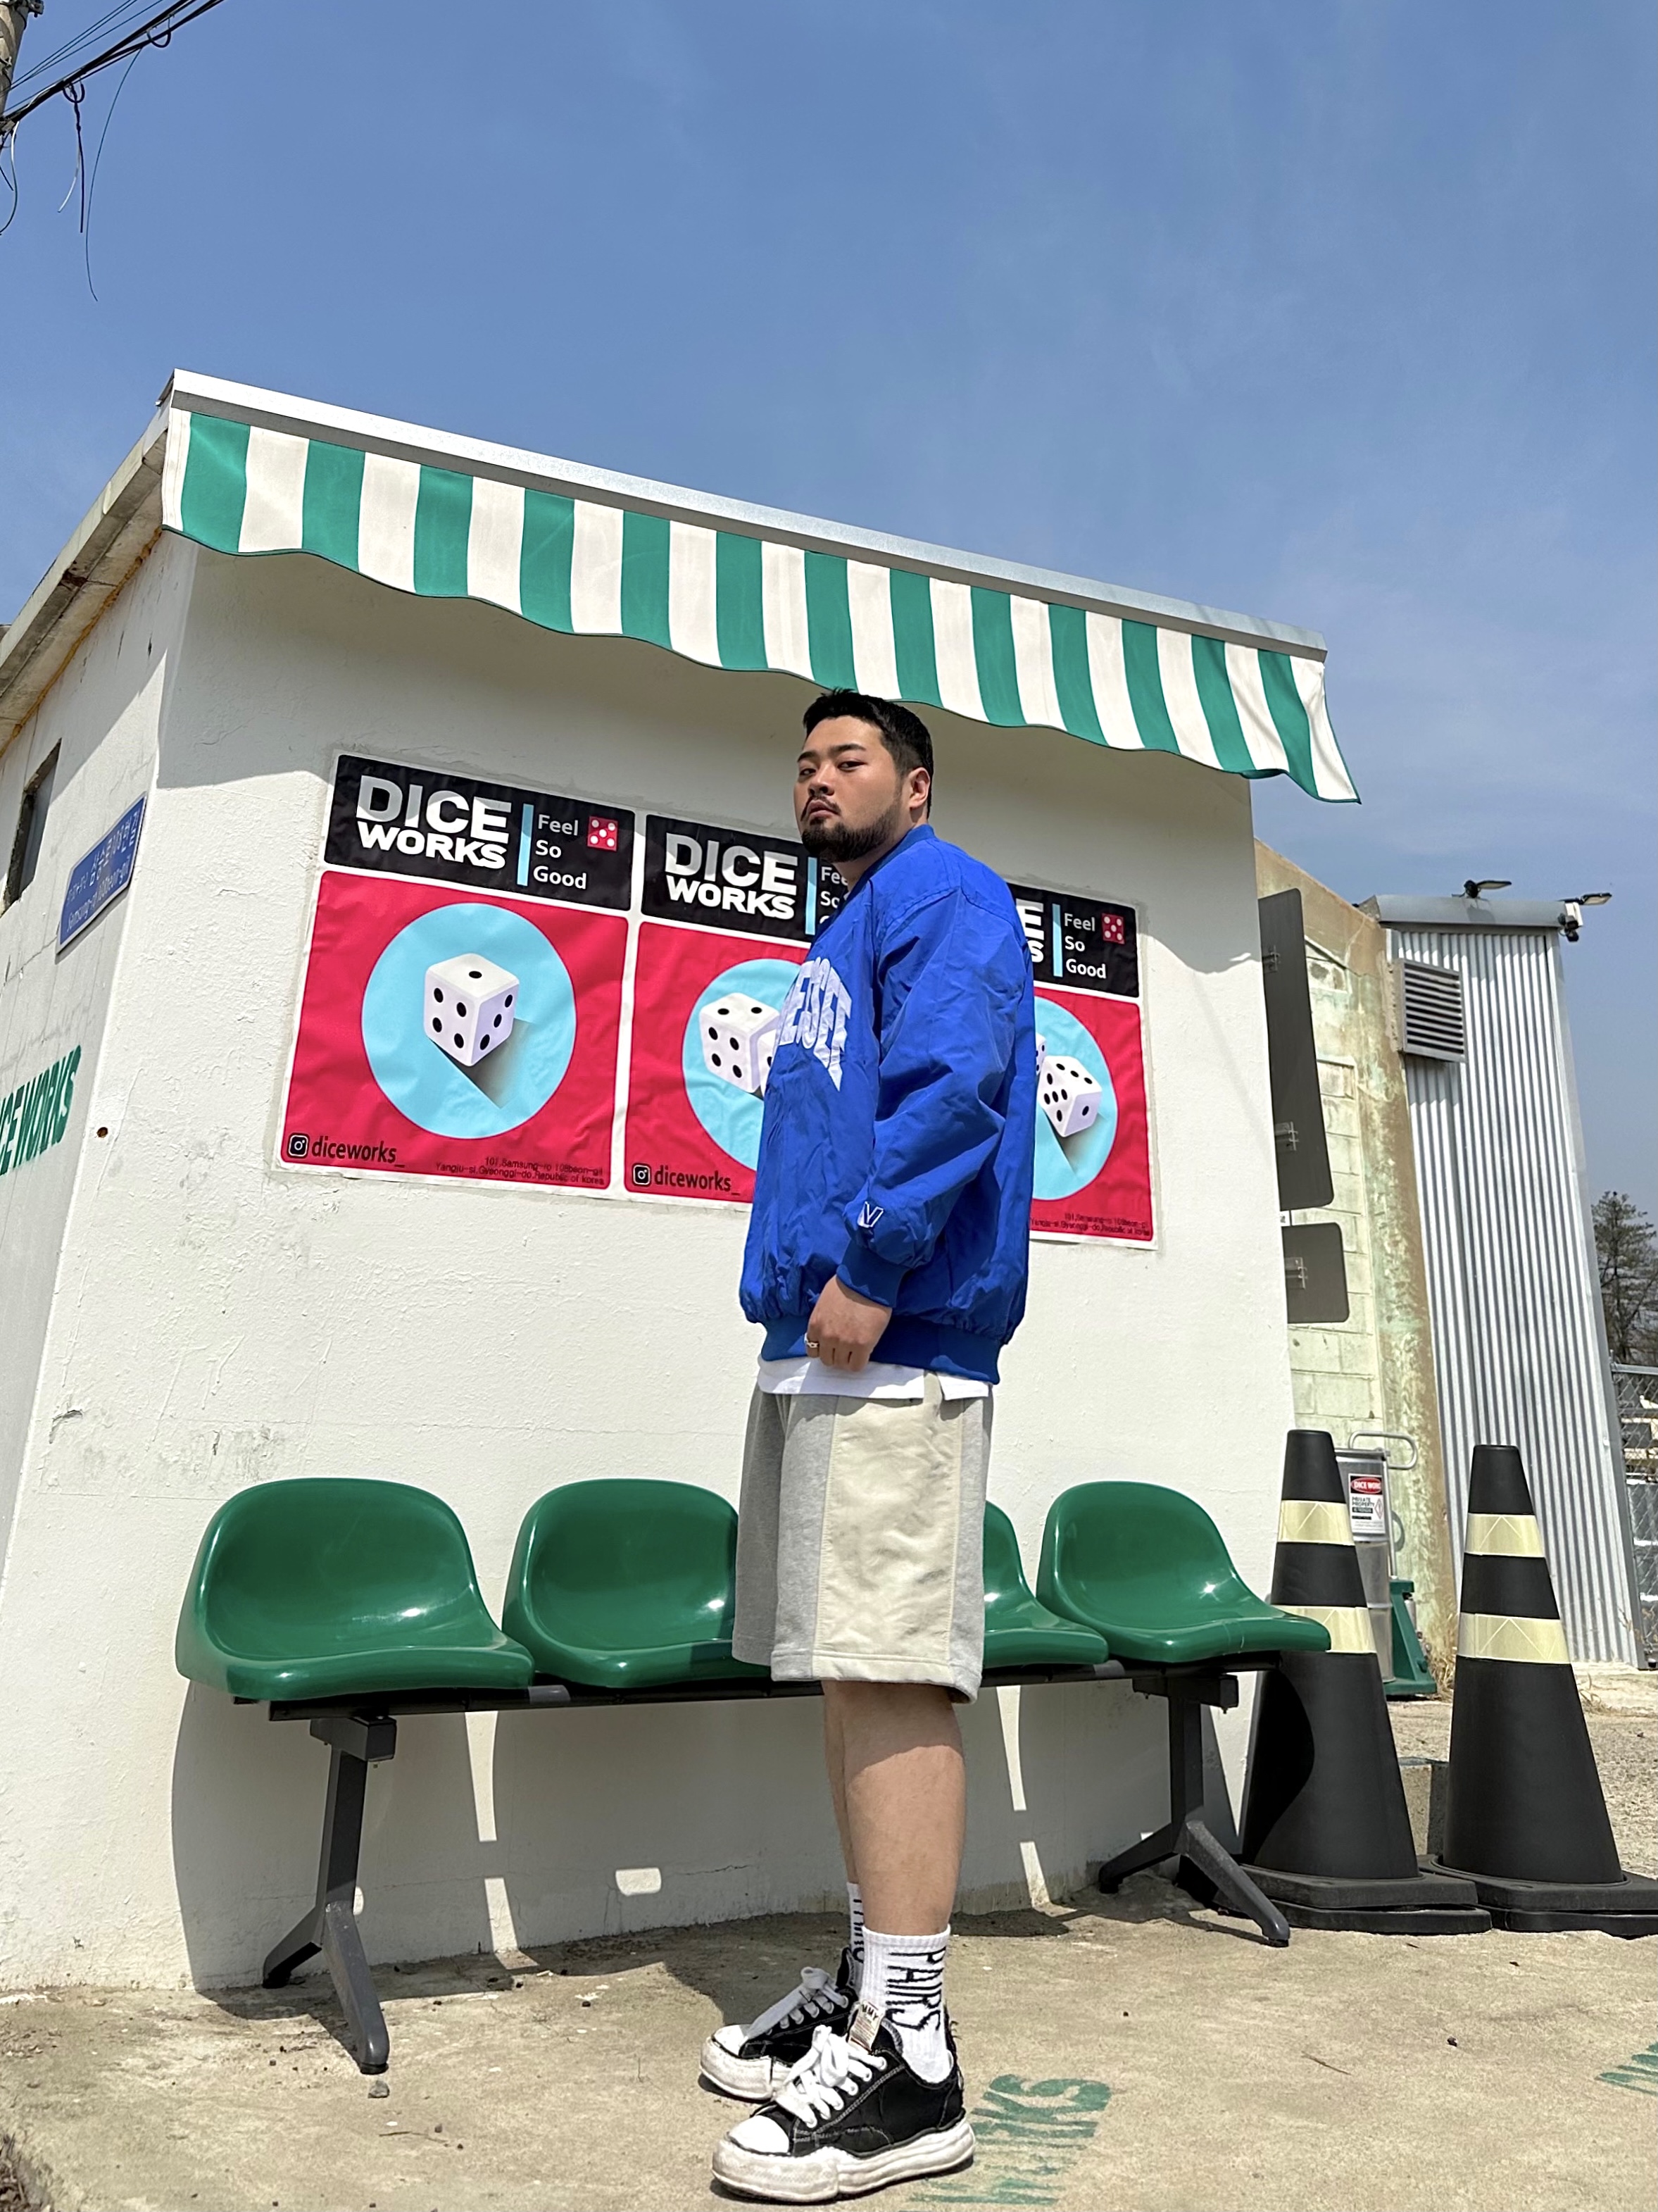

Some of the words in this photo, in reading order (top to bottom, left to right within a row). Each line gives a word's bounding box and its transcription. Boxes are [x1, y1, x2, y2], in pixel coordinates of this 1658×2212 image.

[356, 775, 512, 844] DICE
[537, 813, 579, 837] Feel
[356, 821, 507, 870] WORKS
[535, 840, 562, 859] So
[533, 866, 586, 889] Good
[664, 832, 798, 896] DICE
[665, 875, 796, 920] WORKS
[1064, 913, 1095, 932] Feel
[1064, 935, 1086, 953] So
[1065, 958, 1107, 980] Good
[12, 1044, 82, 1169] WORKS
[886, 1946, 947, 2030] PAIRS
